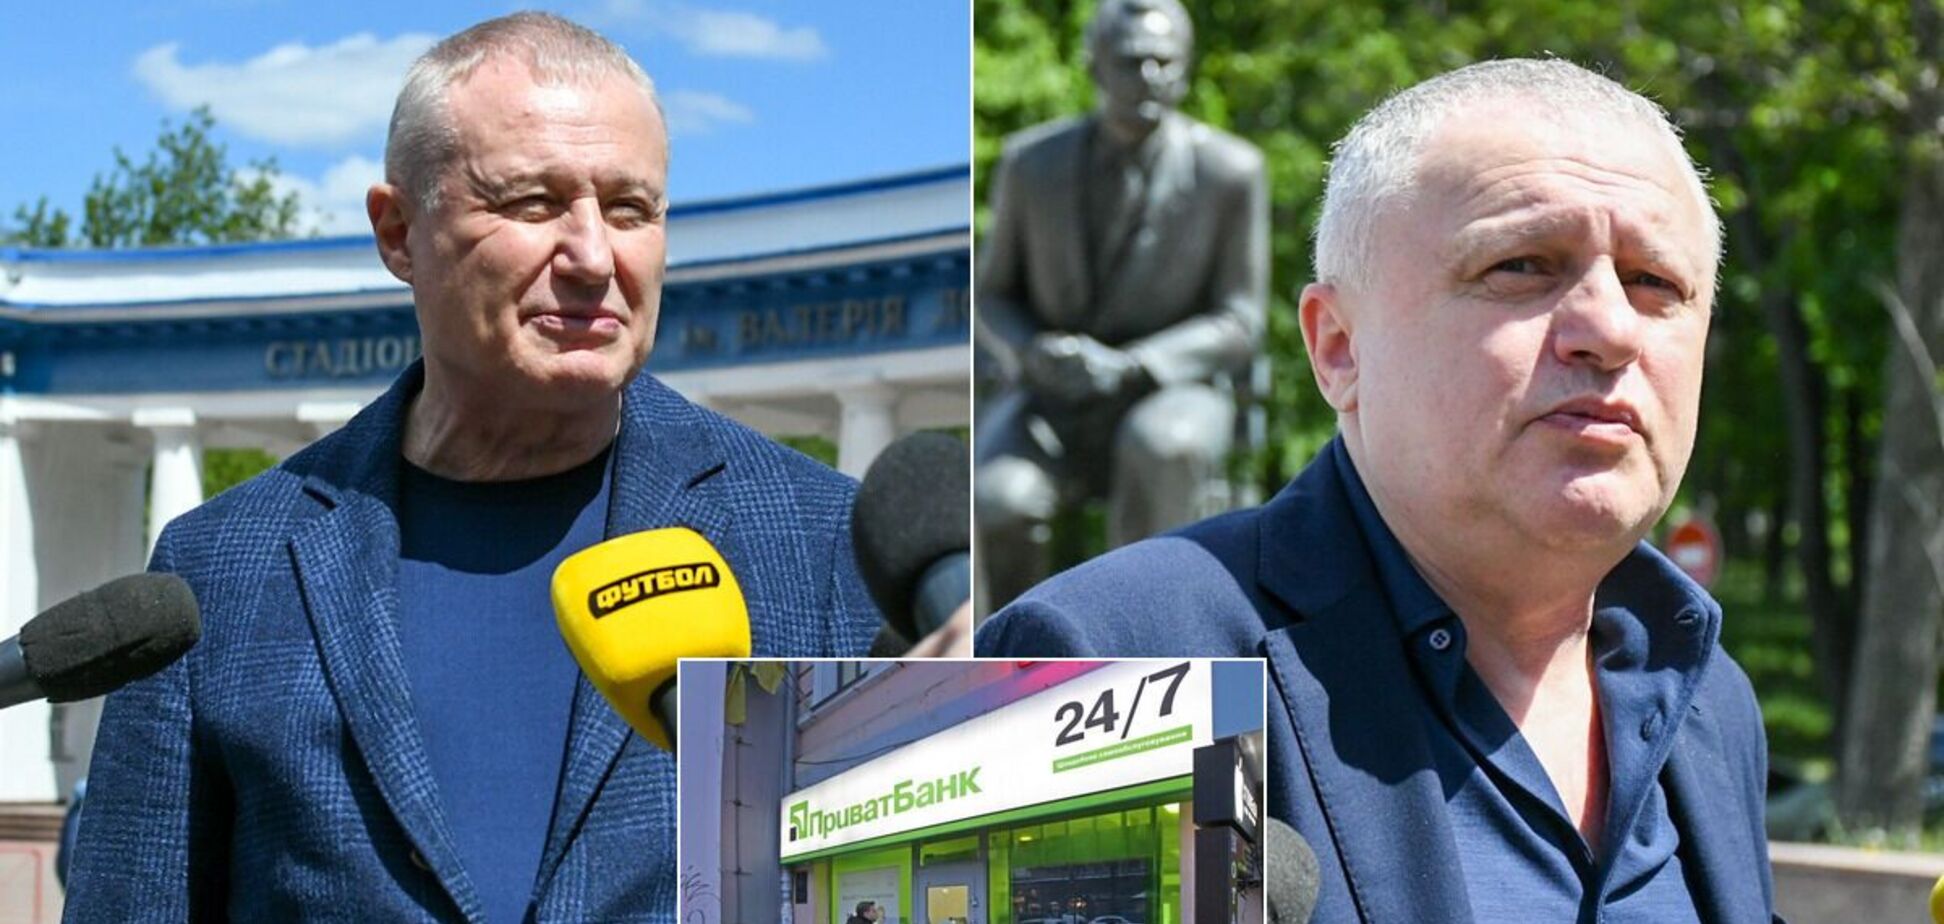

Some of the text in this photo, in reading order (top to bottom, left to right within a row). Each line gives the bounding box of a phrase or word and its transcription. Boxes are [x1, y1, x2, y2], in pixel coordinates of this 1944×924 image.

[739, 298, 906, 343] ВАЛЕРІЯ
[596, 565, 714, 609] ФУТБОЛ
[1054, 661, 1191, 747] 24/7
[809, 767, 982, 838] ПриватБанк
